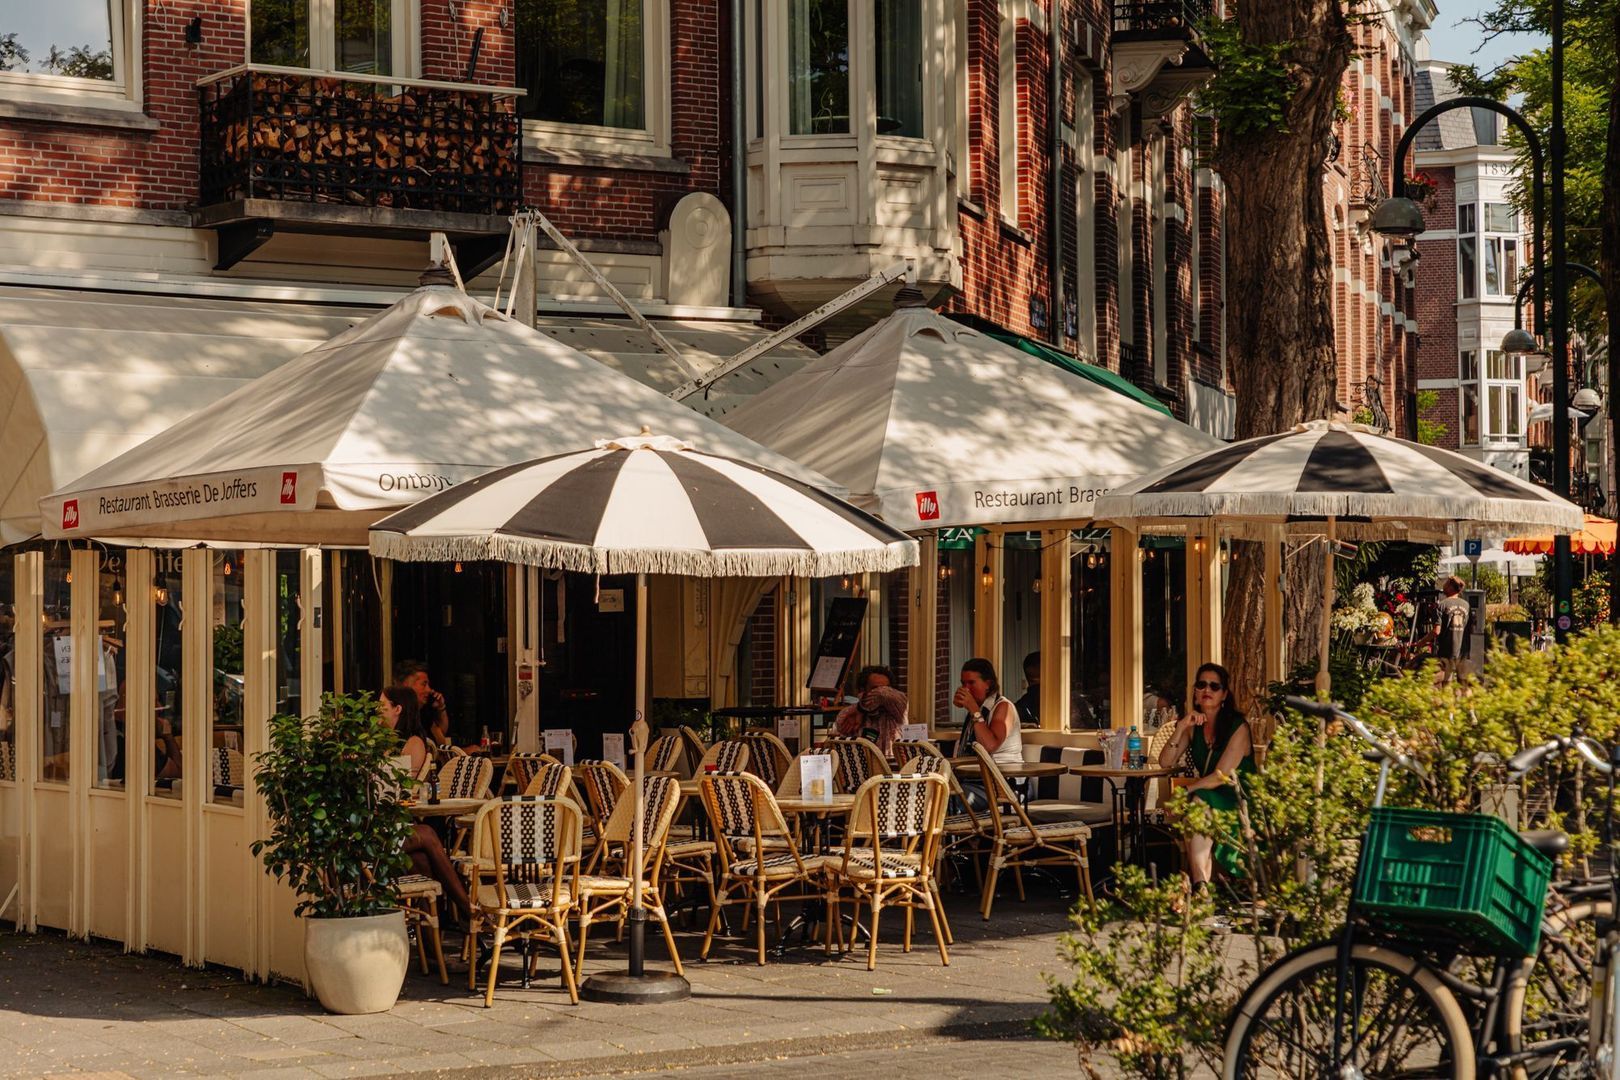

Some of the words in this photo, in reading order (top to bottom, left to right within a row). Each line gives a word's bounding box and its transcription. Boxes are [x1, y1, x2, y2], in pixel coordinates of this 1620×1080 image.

[98, 493, 152, 515] Restaurant
[153, 486, 201, 509] Brasserie
[203, 484, 219, 503] De
[220, 478, 257, 501] Joffers
[974, 488, 1063, 509] Restaurant
[64, 505, 78, 525] illy
[920, 497, 937, 517] illy
[1469, 542, 1477, 554] P
